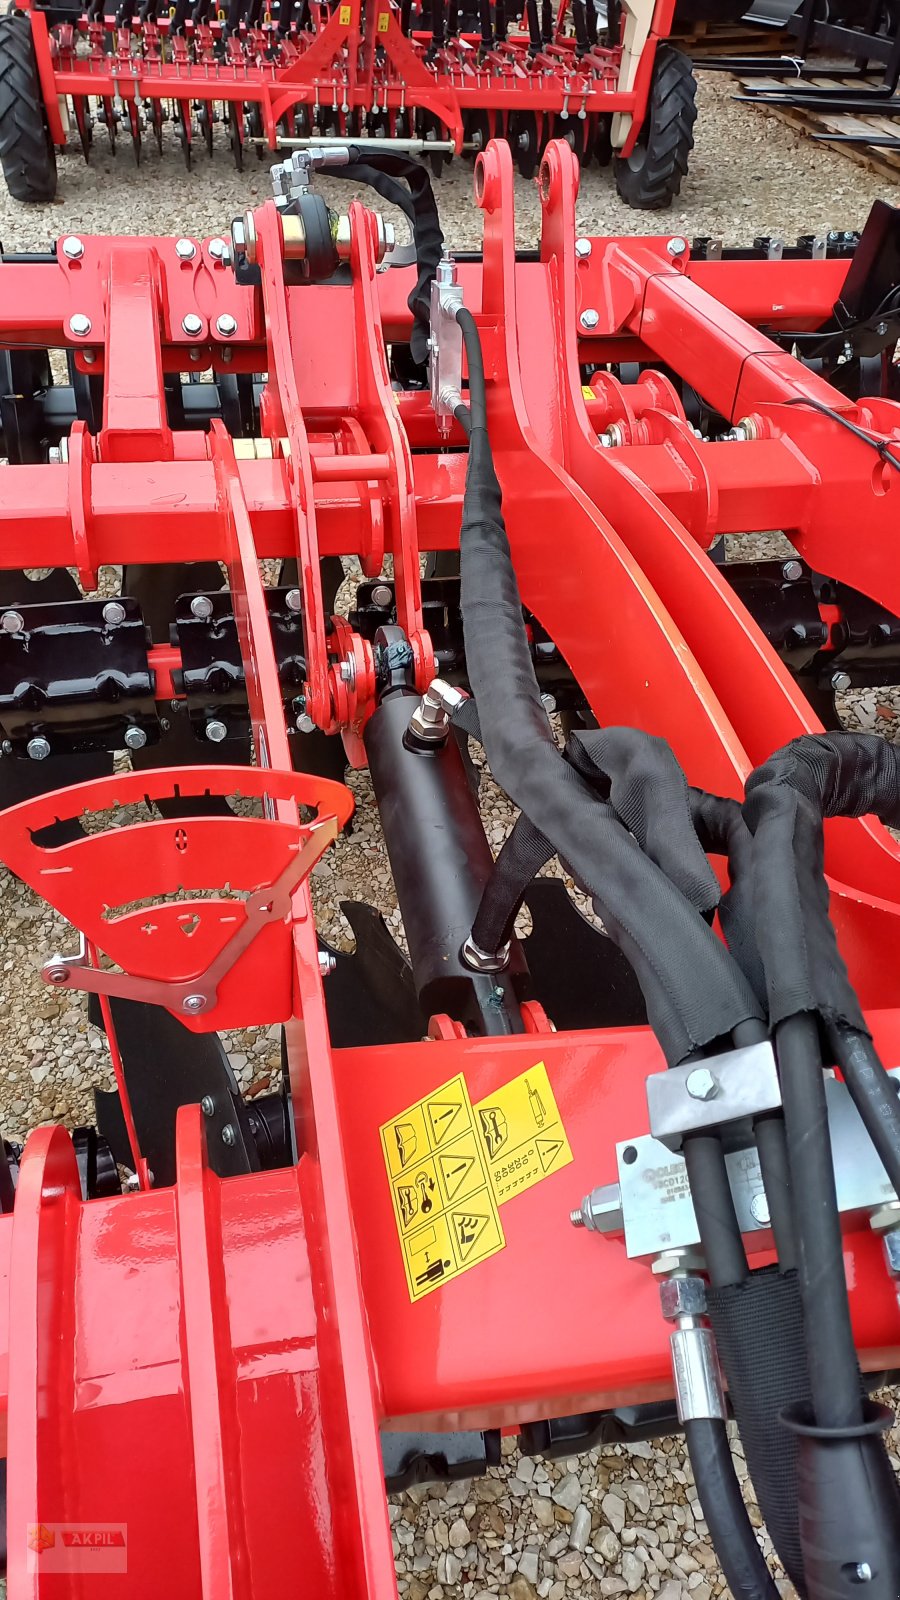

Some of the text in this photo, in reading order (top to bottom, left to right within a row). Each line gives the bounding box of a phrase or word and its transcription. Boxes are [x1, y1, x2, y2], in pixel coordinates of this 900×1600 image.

[507, 1162, 519, 1188] 30 h
[513, 1157, 526, 1184] 20 h
[521, 1154, 532, 1179] 10 h
[532, 1167, 539, 1175] h
[498, 1188, 505, 1196] h
[501, 1167, 512, 1192] 40 h
